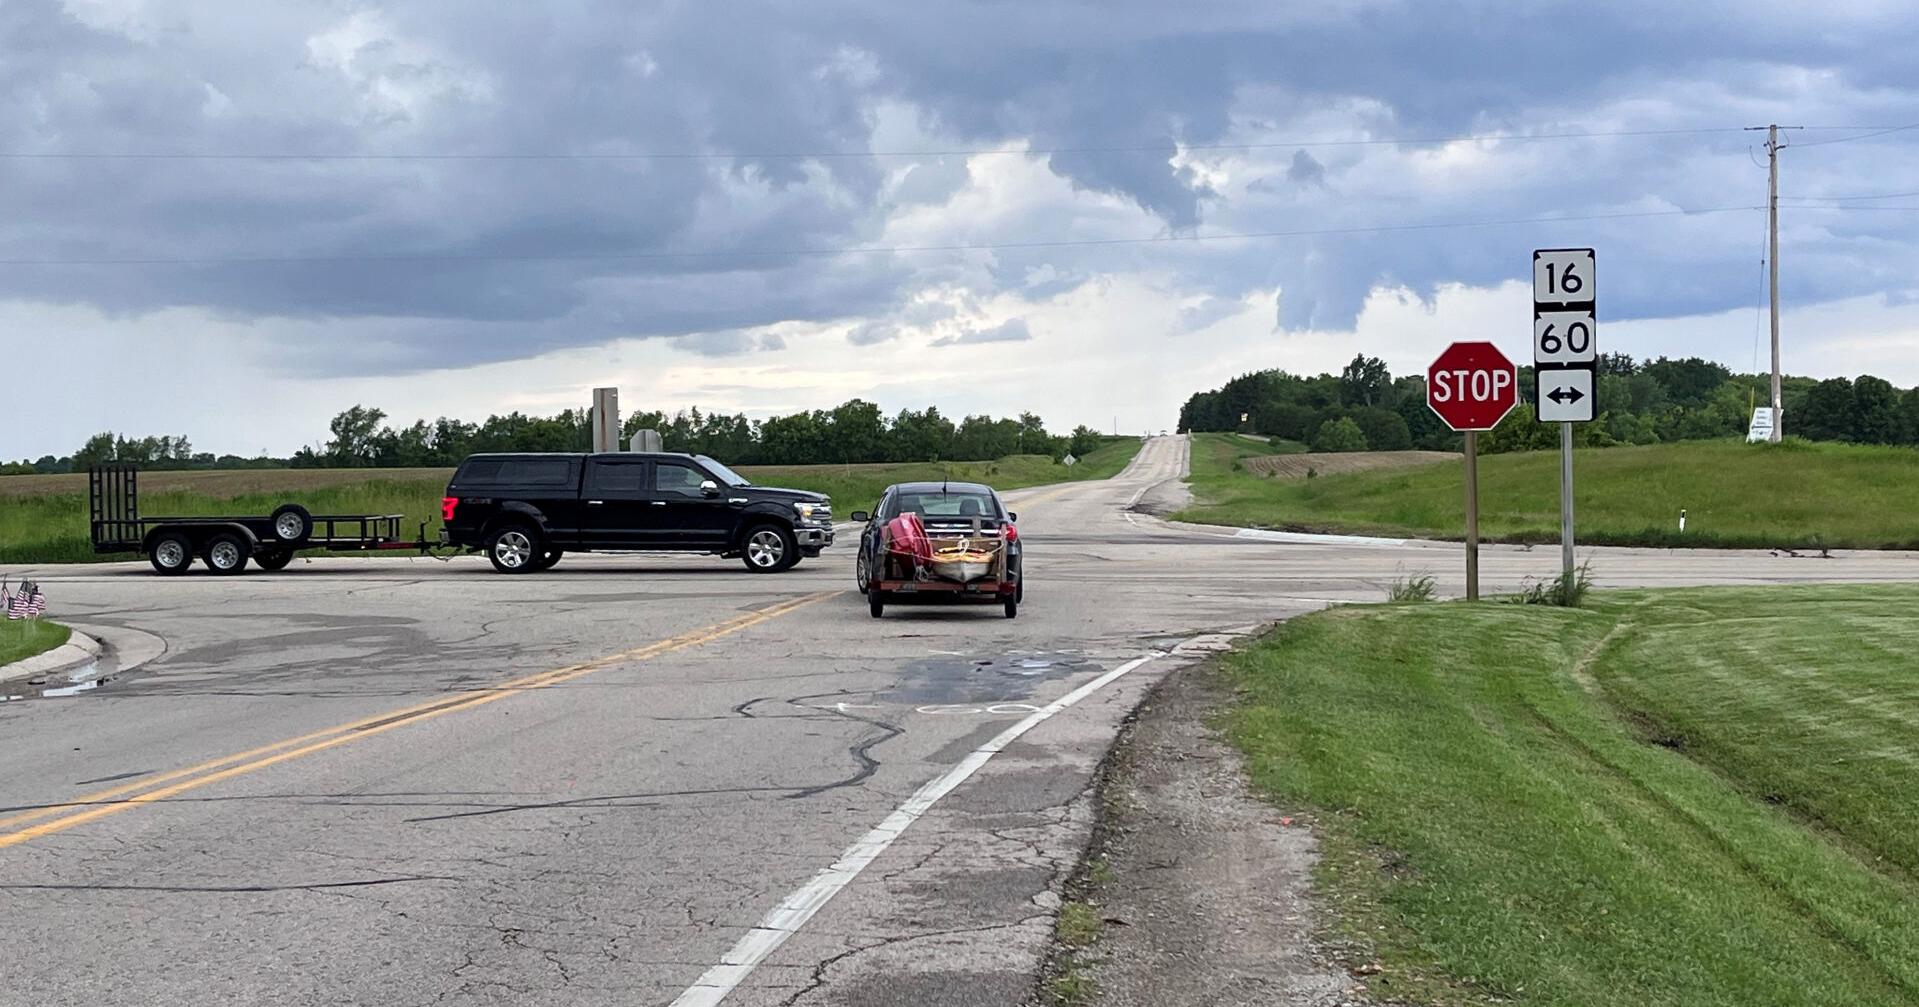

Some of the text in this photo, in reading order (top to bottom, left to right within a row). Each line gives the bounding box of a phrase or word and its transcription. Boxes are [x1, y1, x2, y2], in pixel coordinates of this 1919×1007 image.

[1545, 262, 1583, 294] 16
[1540, 321, 1590, 354] 60
[1433, 369, 1511, 403] STOP
